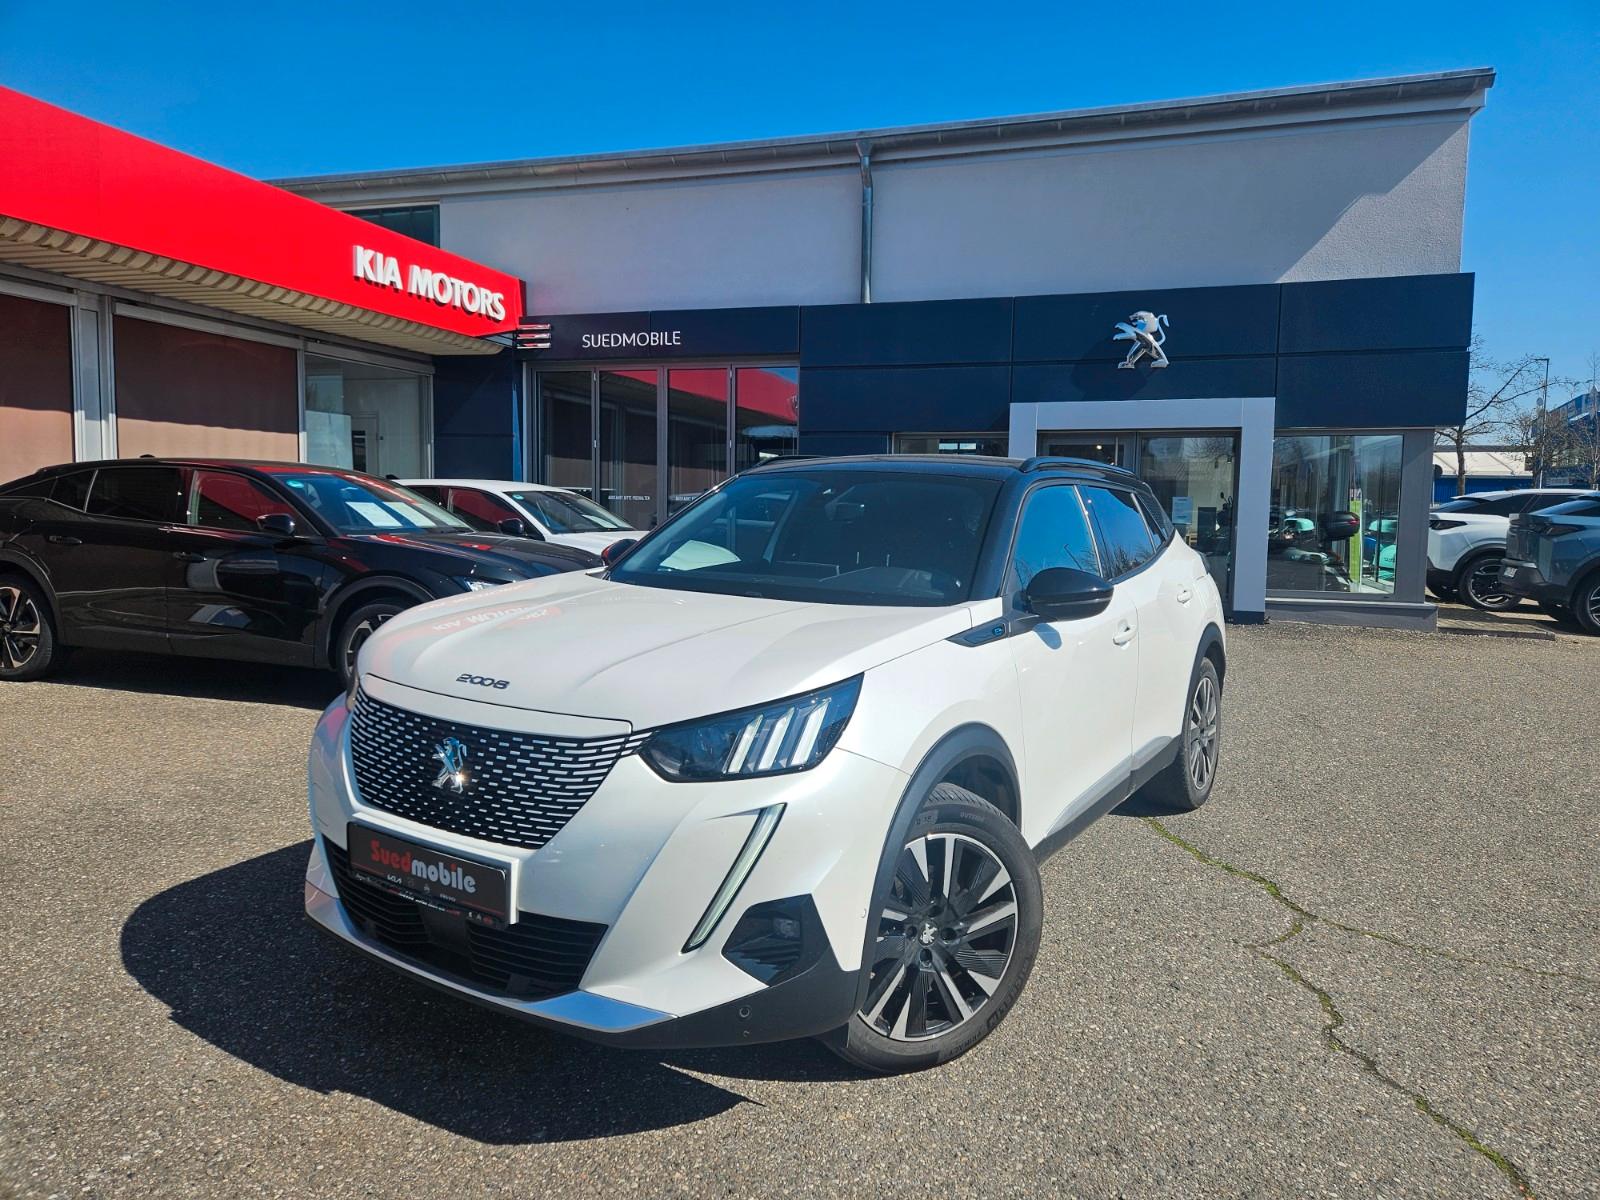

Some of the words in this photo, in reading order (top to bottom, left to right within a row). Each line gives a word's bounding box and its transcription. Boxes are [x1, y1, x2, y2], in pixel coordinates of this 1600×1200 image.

[353, 245, 403, 290] KIA
[408, 264, 506, 321] MOTORS
[582, 330, 681, 348] SUEDMOBILE
[455, 673, 510, 690] 2008
[370, 839, 477, 894] Suedmobile
